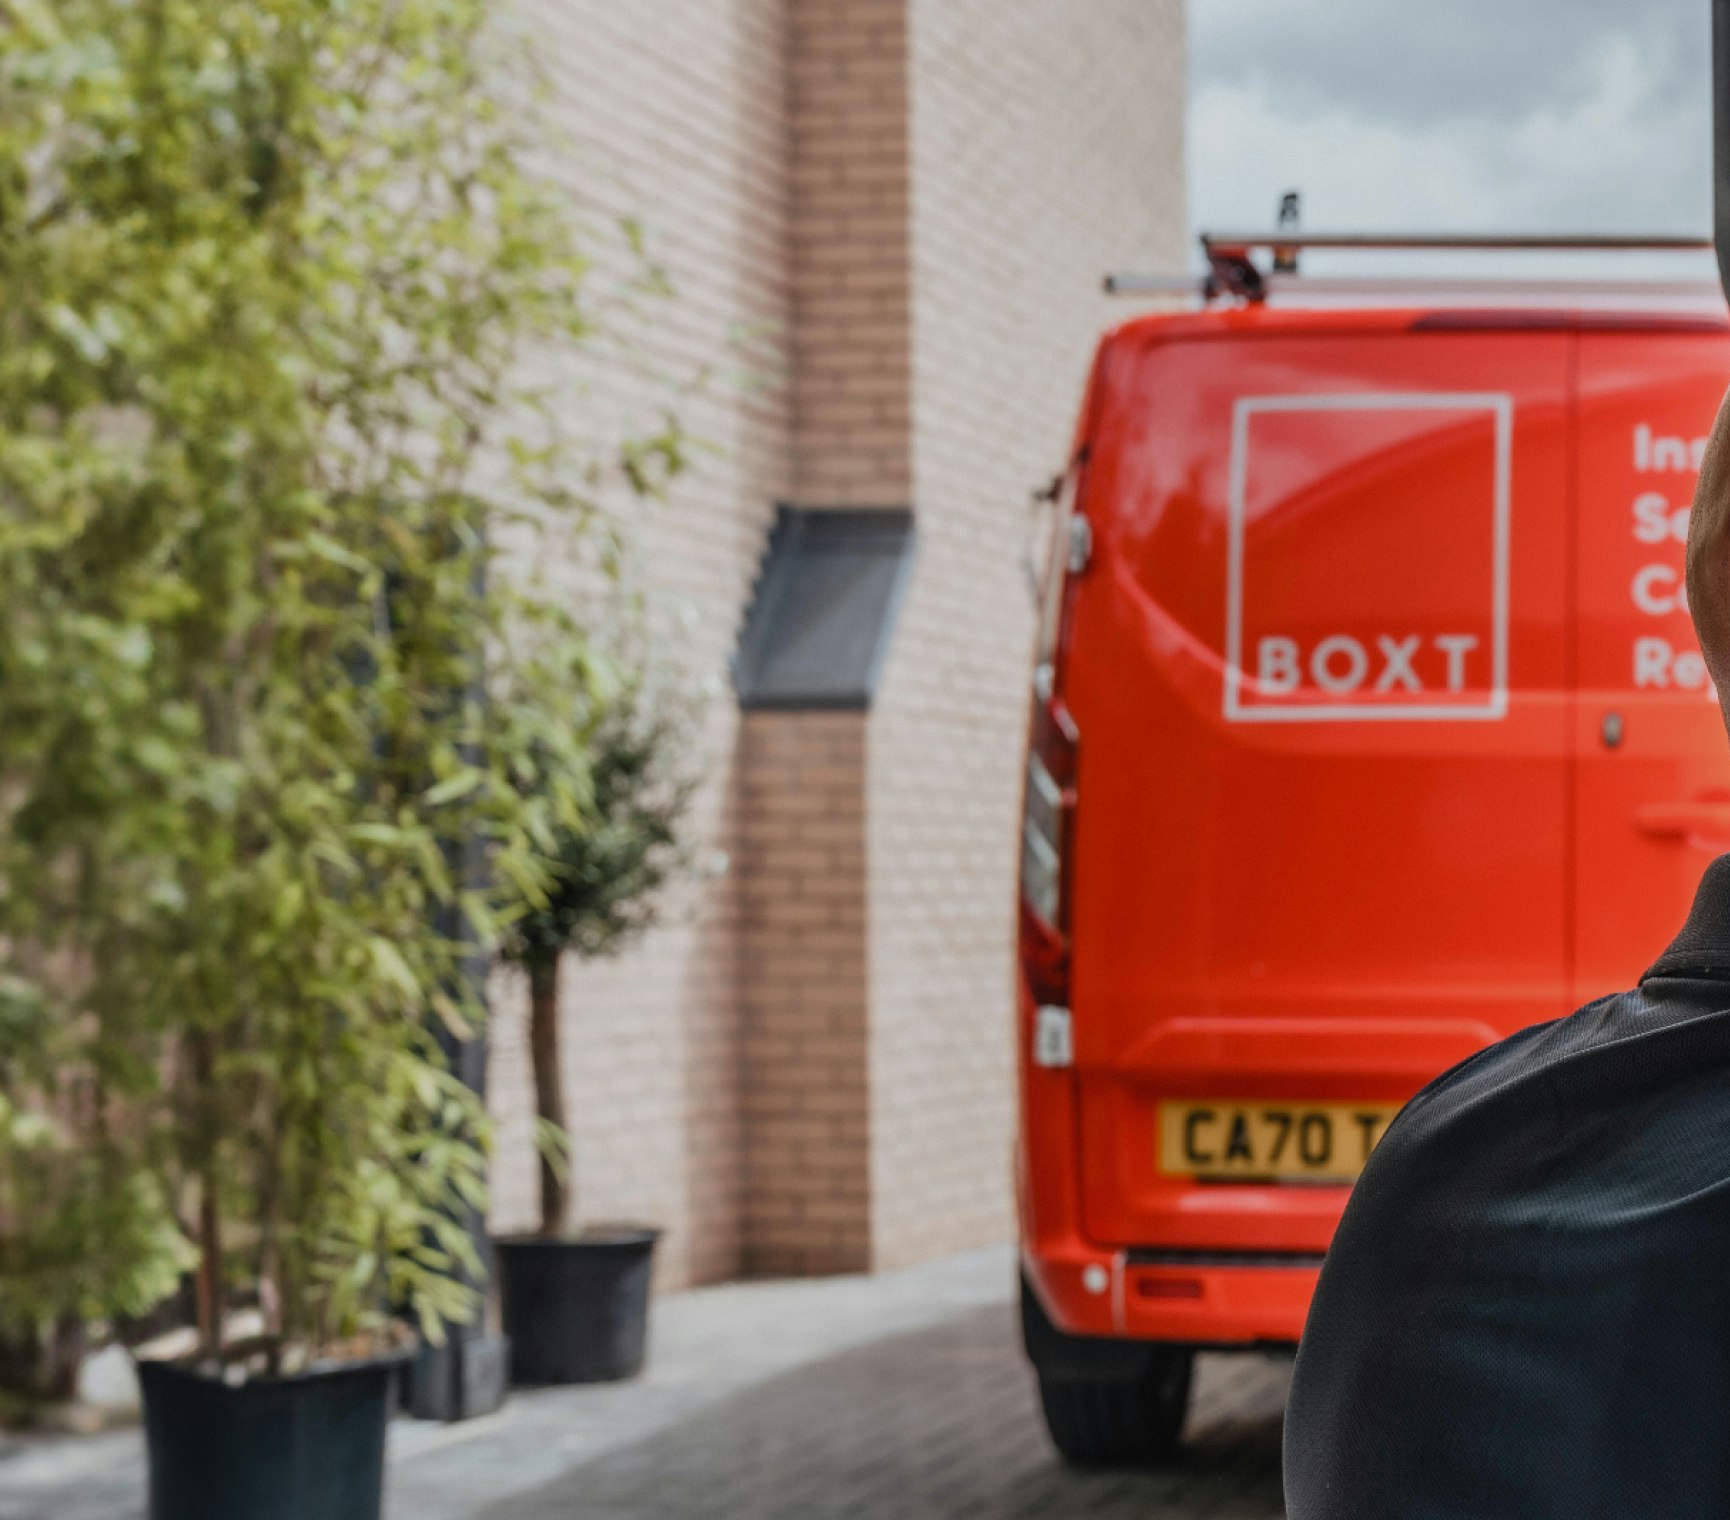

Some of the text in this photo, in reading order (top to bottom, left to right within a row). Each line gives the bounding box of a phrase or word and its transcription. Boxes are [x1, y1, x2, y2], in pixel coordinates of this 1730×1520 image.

[1631, 562, 1691, 615] C
[1257, 634, 1479, 696] BOXT
[1633, 635, 1719, 703] Re
[1184, 1109, 1332, 1167] CA70
